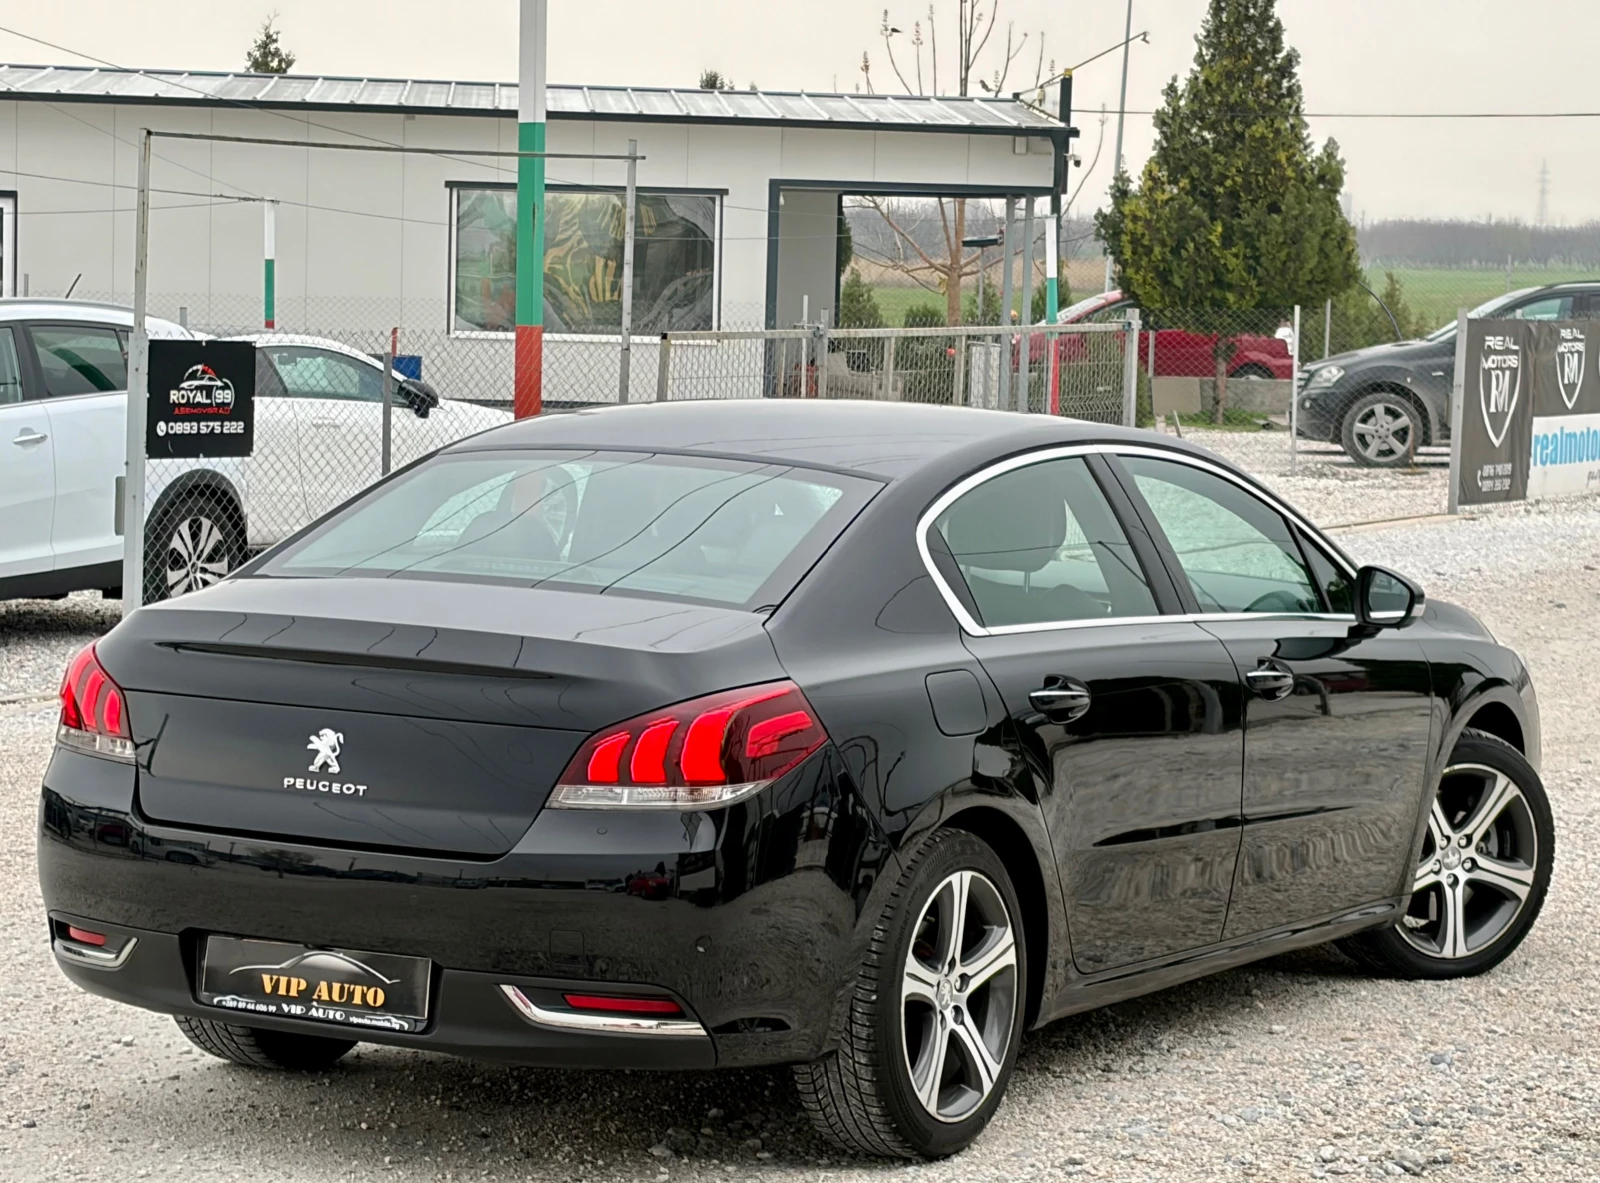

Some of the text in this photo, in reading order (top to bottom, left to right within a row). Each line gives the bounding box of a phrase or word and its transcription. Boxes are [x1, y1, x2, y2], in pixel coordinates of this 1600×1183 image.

[1560, 328, 1585, 339] REAL
[1484, 336, 1520, 350] REAL
[1481, 355, 1519, 370] MOTORS
[169, 390, 211, 404] ROYAL
[168, 421, 245, 434] 0893 575 222
[1533, 426, 1600, 467] realmoto
[283, 777, 368, 797] PEUGEOT
[261, 973, 385, 1008] VIP AUTO
[281, 1002, 346, 1020] VIP AUTO
